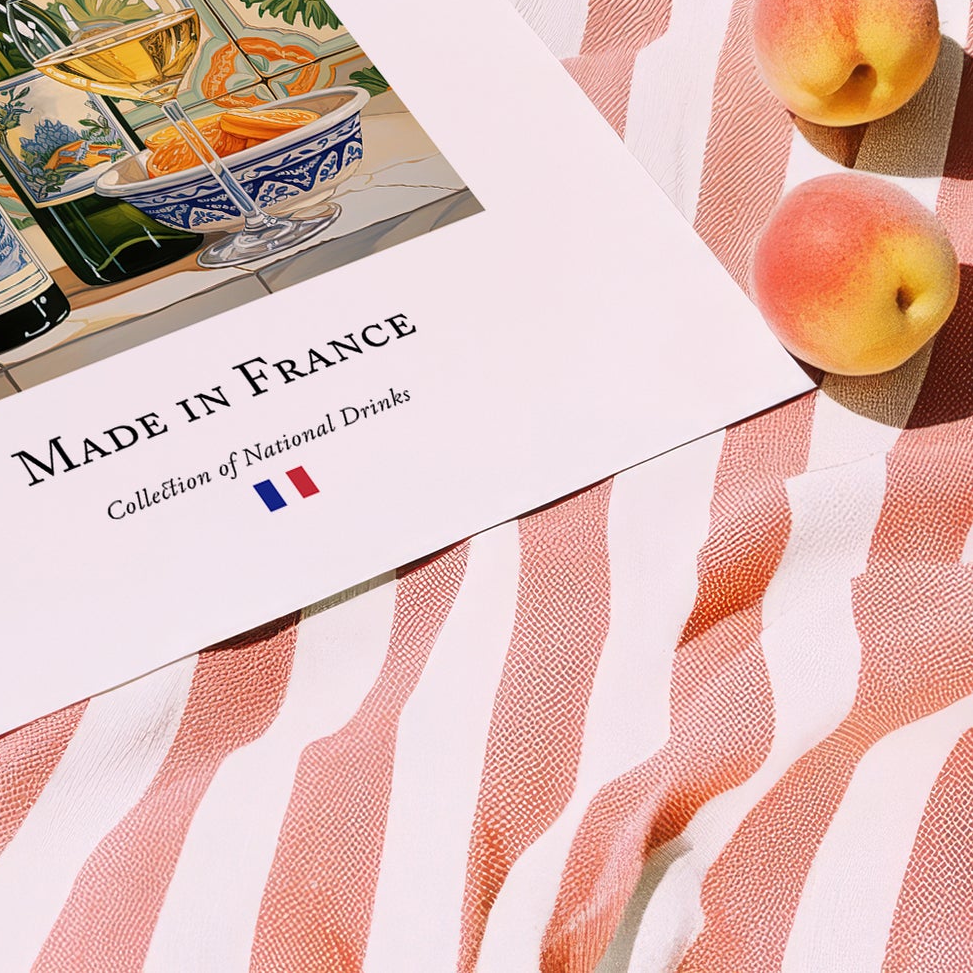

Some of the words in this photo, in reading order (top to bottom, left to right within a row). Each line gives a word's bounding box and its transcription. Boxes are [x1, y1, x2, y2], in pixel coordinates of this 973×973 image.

[107, 471, 212, 520] Collection
[218, 451, 238, 480] of
[242, 413, 336, 467] National
[340, 388, 411, 427] Drinks
